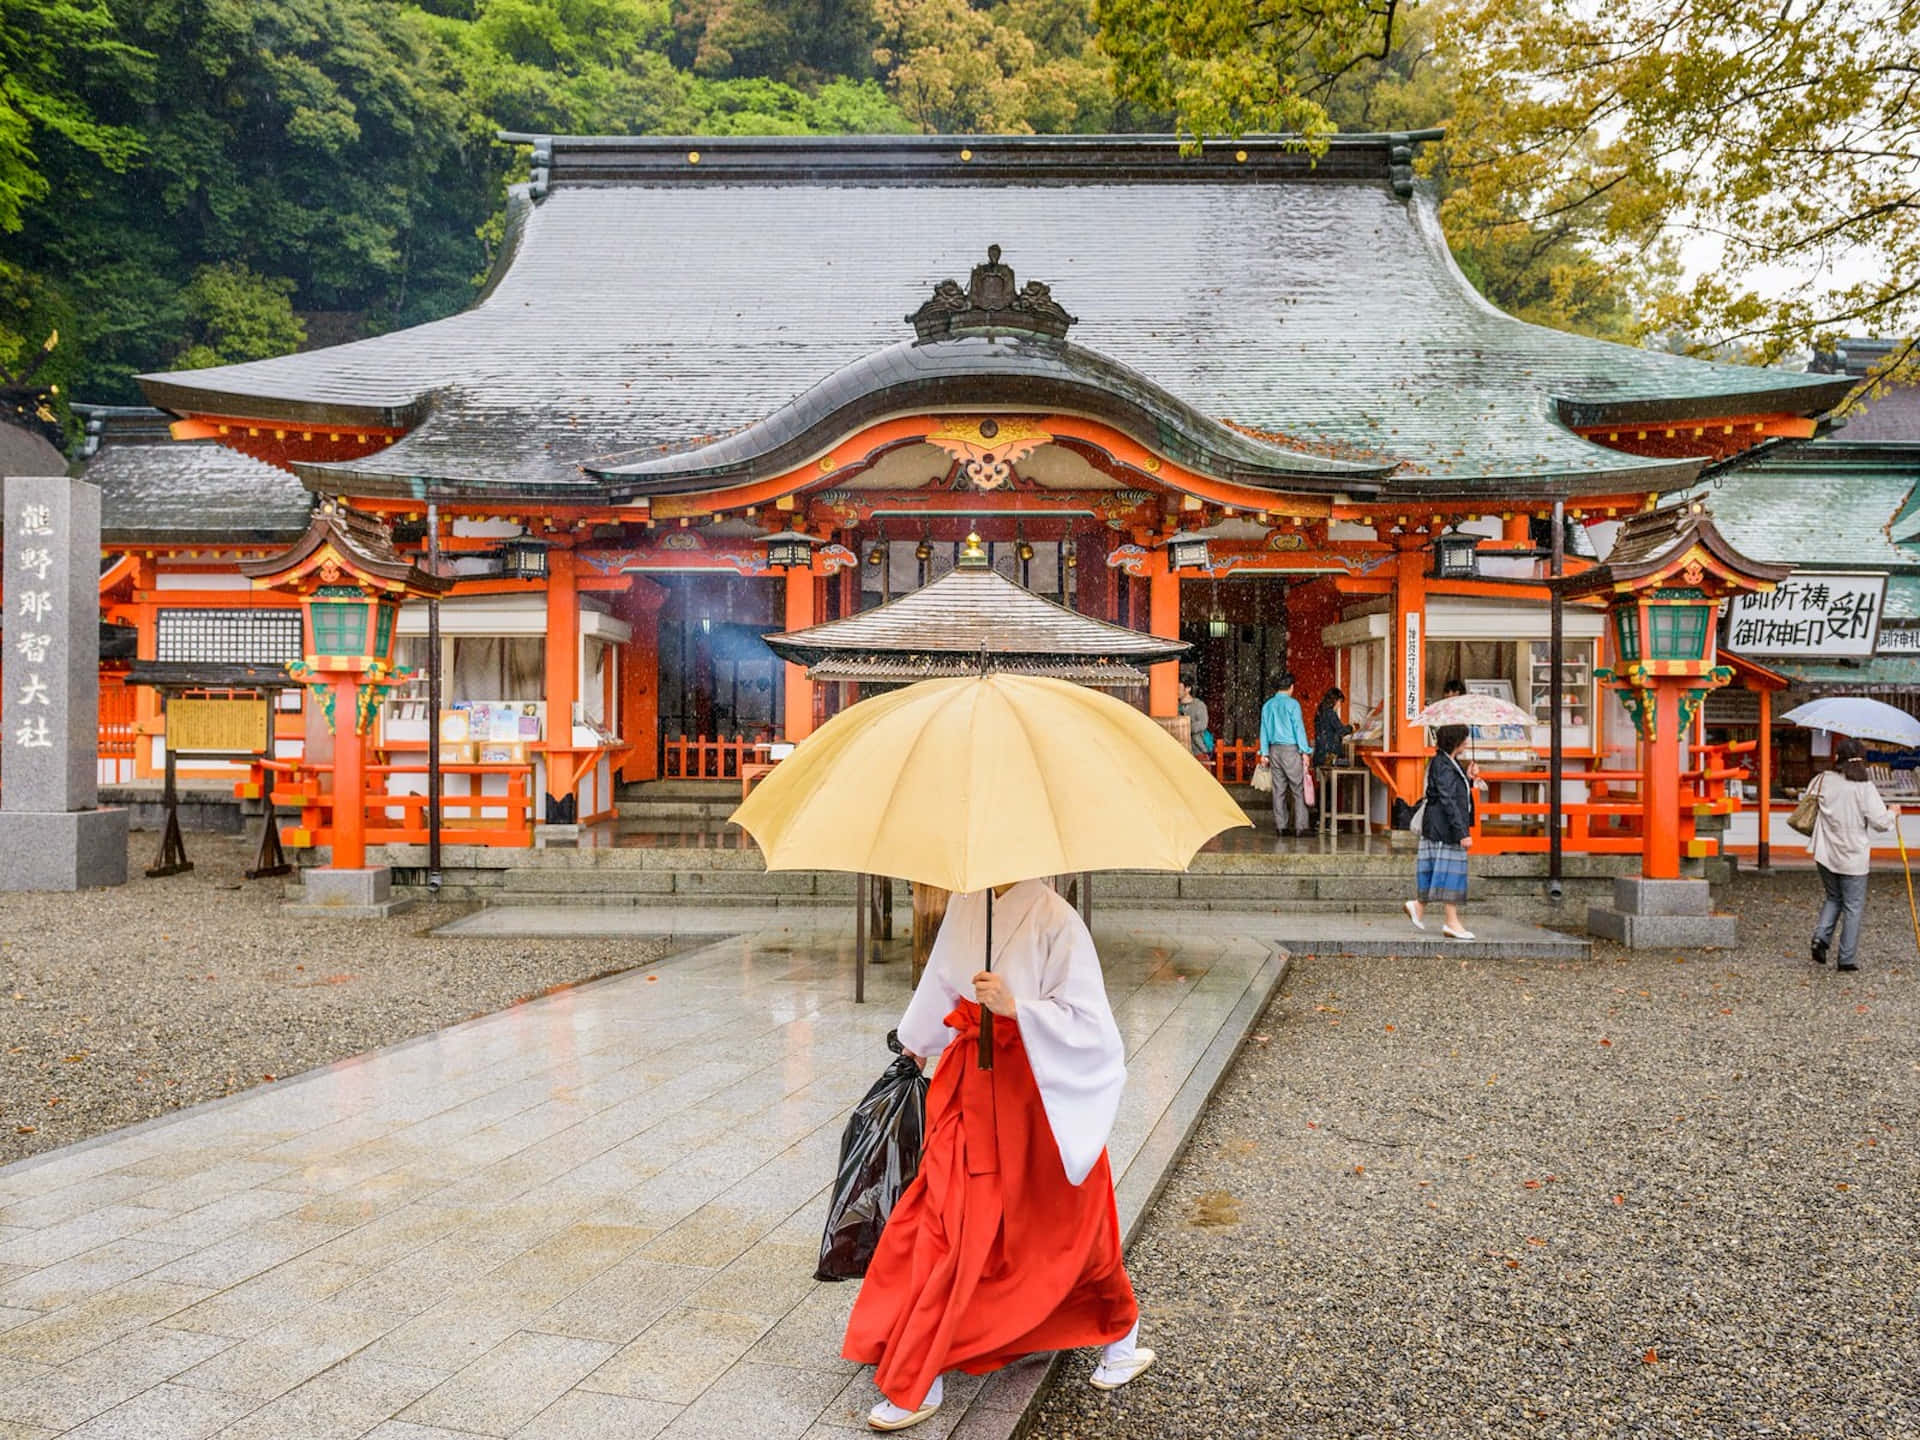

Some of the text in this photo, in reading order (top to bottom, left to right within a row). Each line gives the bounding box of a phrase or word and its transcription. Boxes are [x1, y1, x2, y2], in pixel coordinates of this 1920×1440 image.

[17, 504, 53, 748] 熊野那智大社
[1733, 619, 1824, 647] 御神印
[1826, 590, 1876, 639] 受付
